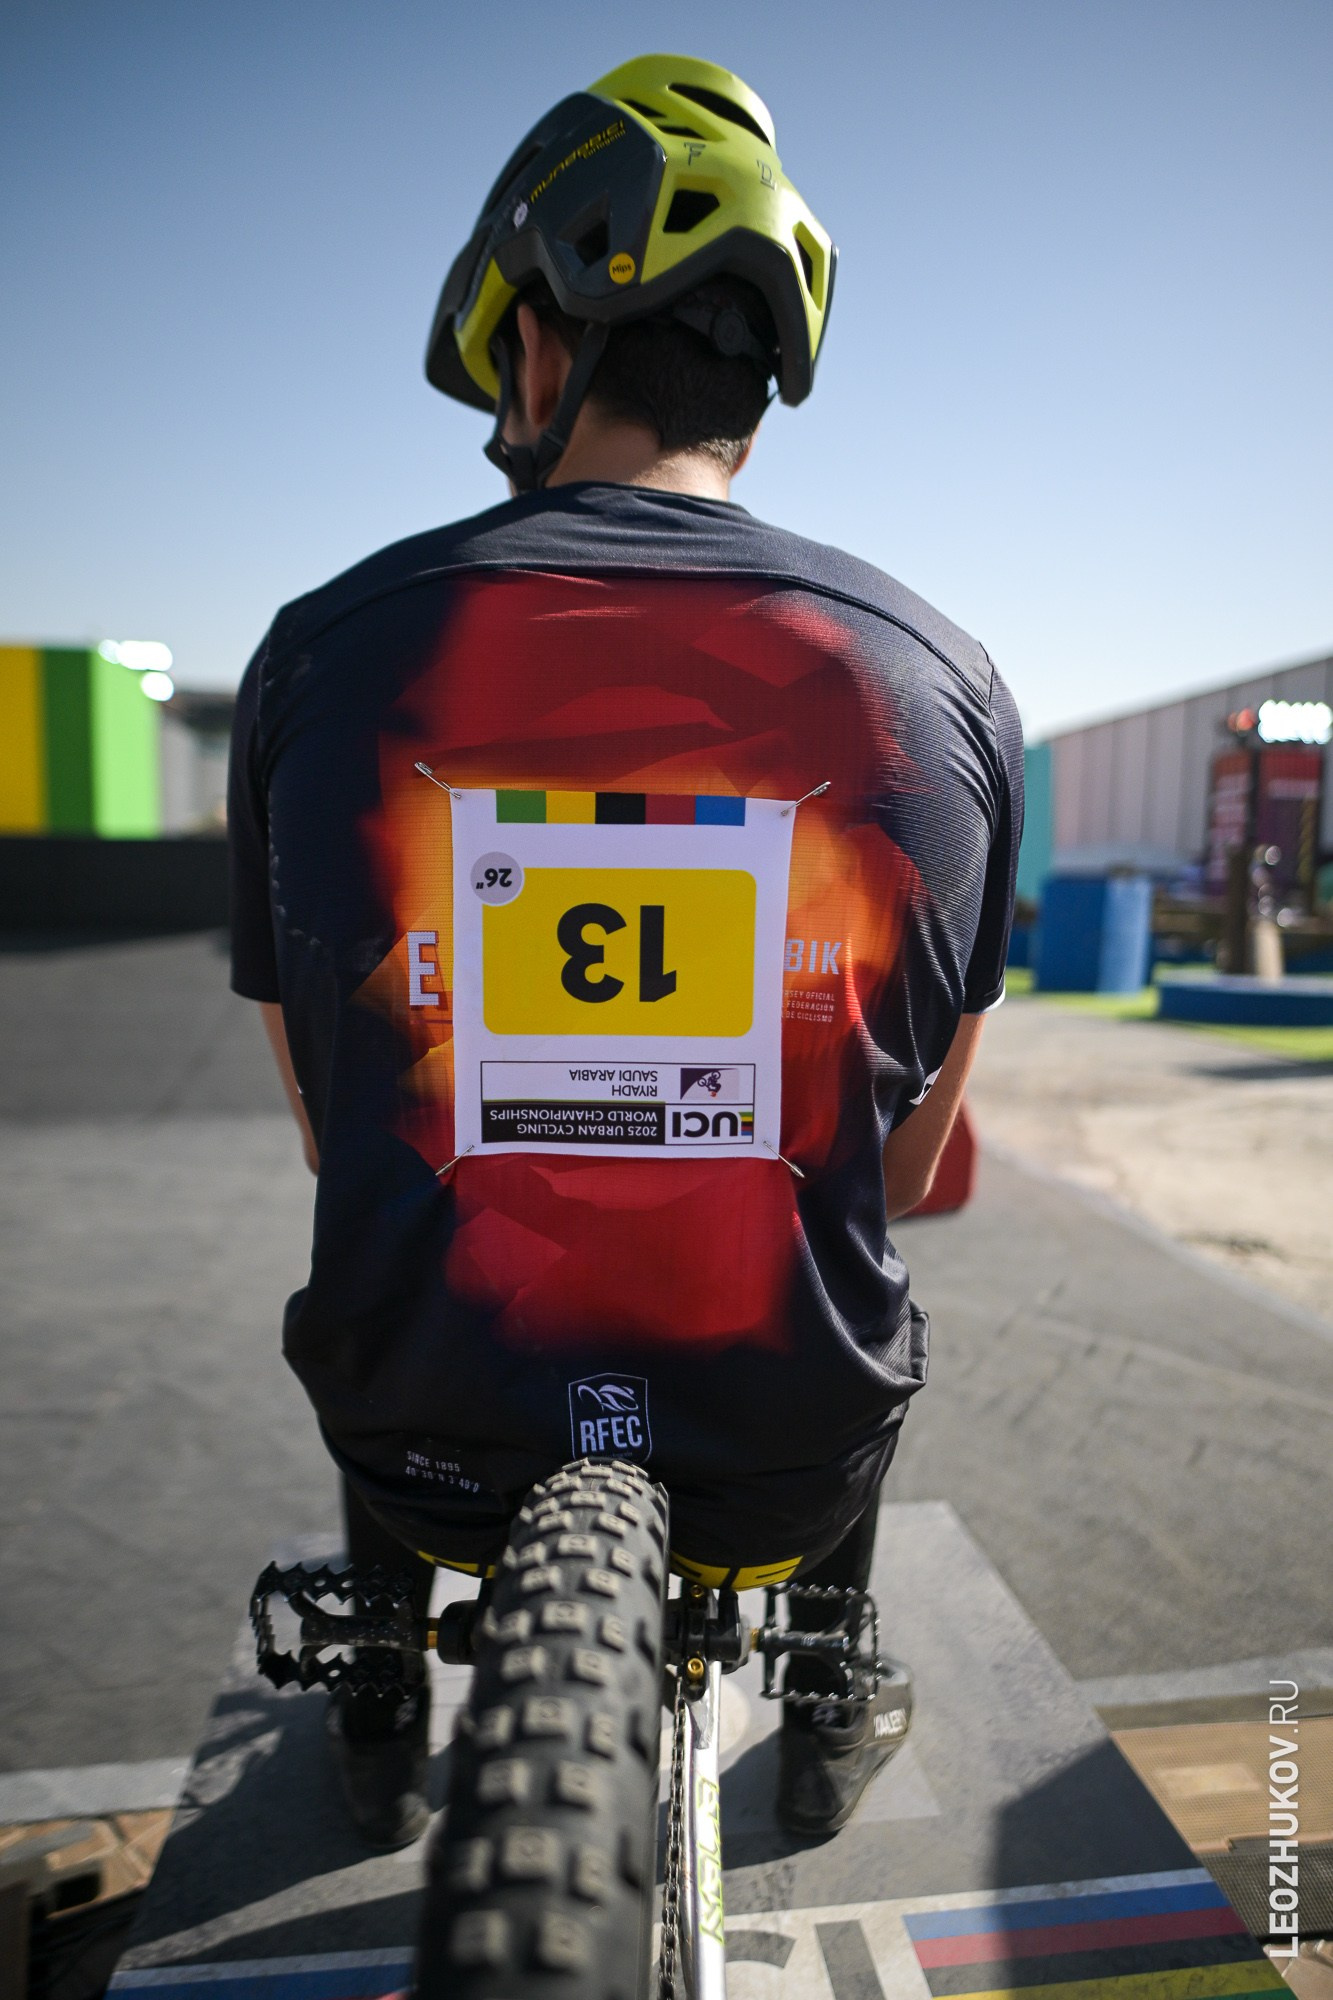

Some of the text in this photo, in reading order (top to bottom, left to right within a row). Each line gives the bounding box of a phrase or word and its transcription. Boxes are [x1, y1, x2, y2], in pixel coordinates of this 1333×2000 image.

[476, 867, 513, 889] 26"
[557, 902, 677, 1004] 13
[783, 938, 842, 975] BIK
[805, 991, 835, 1001] OFICIAL
[797, 1011, 833, 1023] CICLISMO
[569, 1069, 658, 1082] SAUDI ARABIA
[611, 1085, 658, 1097] RIYADH
[490, 1109, 658, 1122] WORLD CHAMPIONSHIPS
[517, 1123, 658, 1137] 2025 URBAN CYCLING
[672, 1111, 739, 1138] UCI
[580, 1415, 643, 1453] RFEC
[406, 1450, 430, 1468] SINCE
